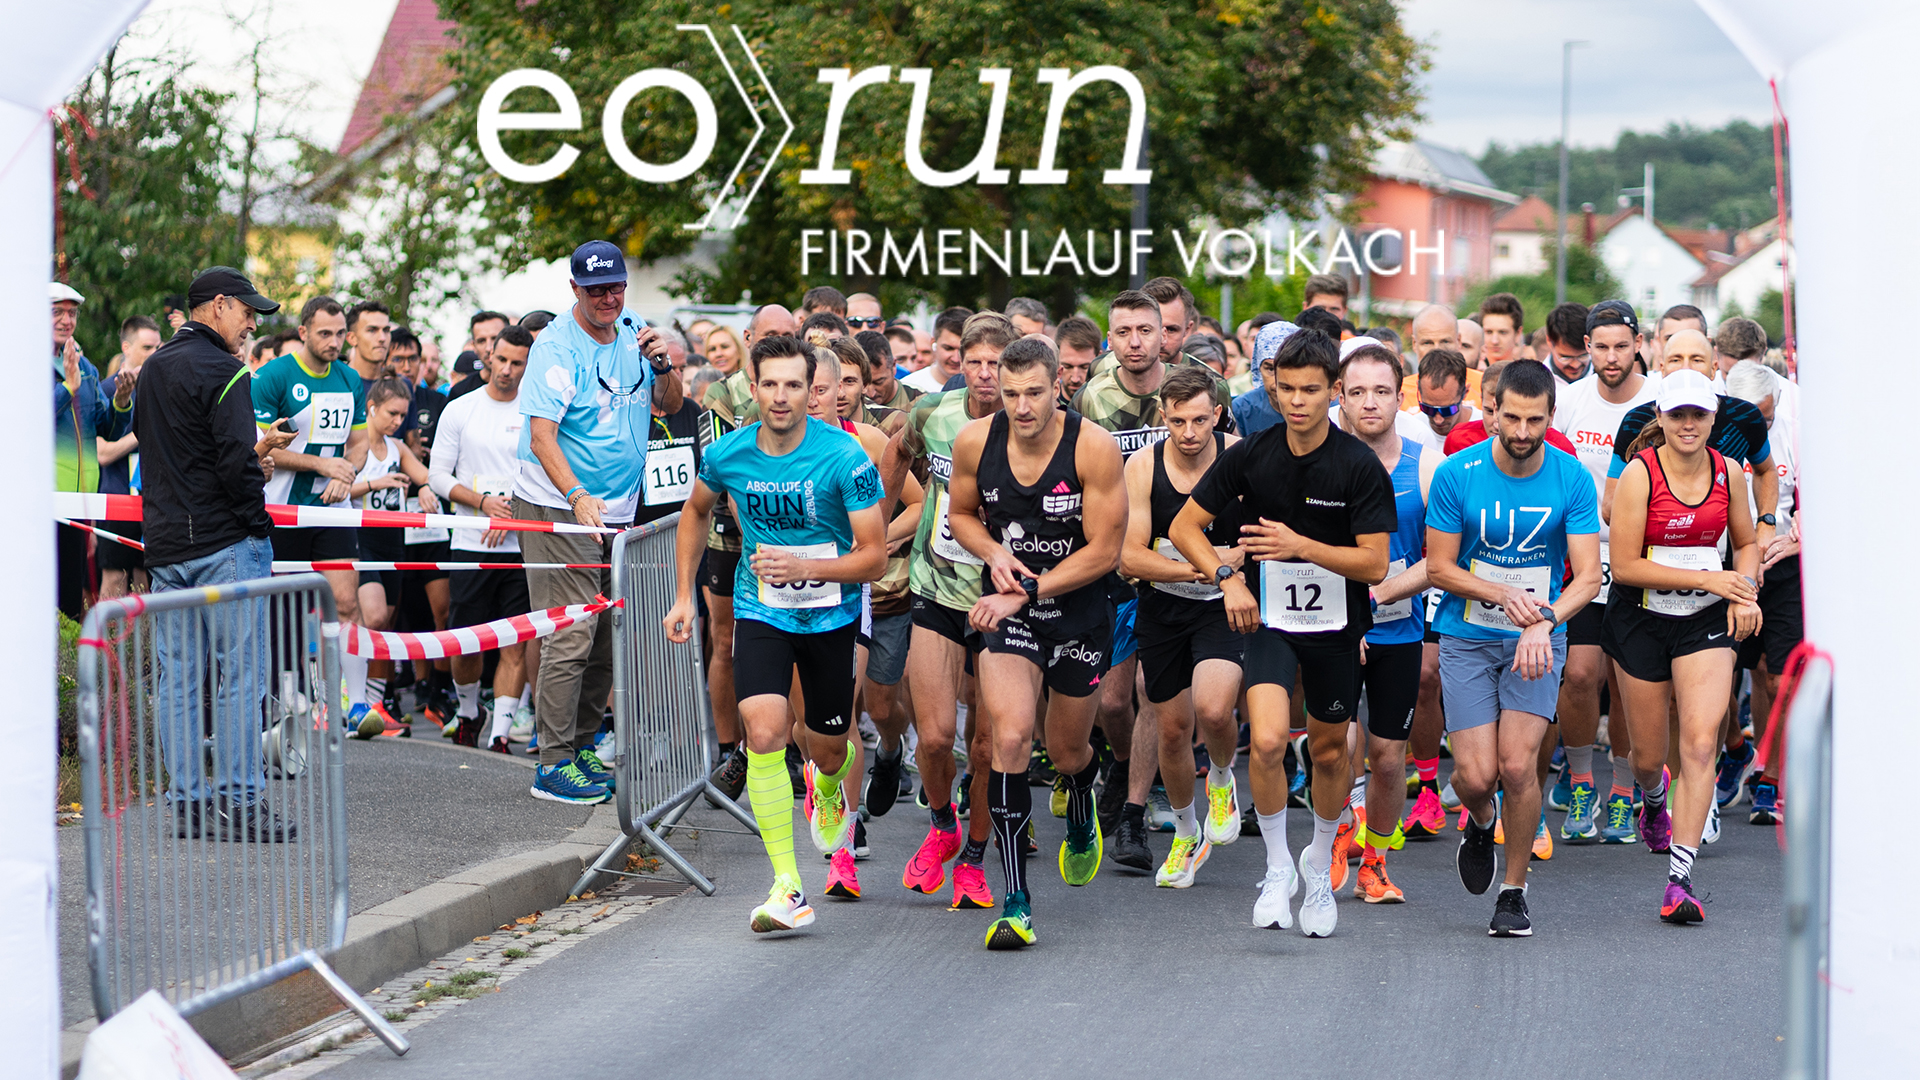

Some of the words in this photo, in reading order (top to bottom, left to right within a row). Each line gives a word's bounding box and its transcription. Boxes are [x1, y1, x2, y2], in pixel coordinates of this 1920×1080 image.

[593, 259, 614, 269] eology
[297, 388, 304, 397] B
[319, 408, 350, 429] 317
[1597, 448, 1610, 456] ON
[932, 457, 952, 477] SPO
[651, 463, 689, 489] 116
[745, 480, 801, 493] ABSOLUTE
[746, 493, 804, 517] RUN
[753, 517, 805, 532] CREW
[1012, 533, 1074, 557] eology
[1478, 550, 1546, 565] MAINFRANKEN
[1683, 553, 1697, 561] run
[1296, 568, 1314, 576] run
[1285, 583, 1324, 612] 12
[1402, 707, 1415, 730] FUSION
